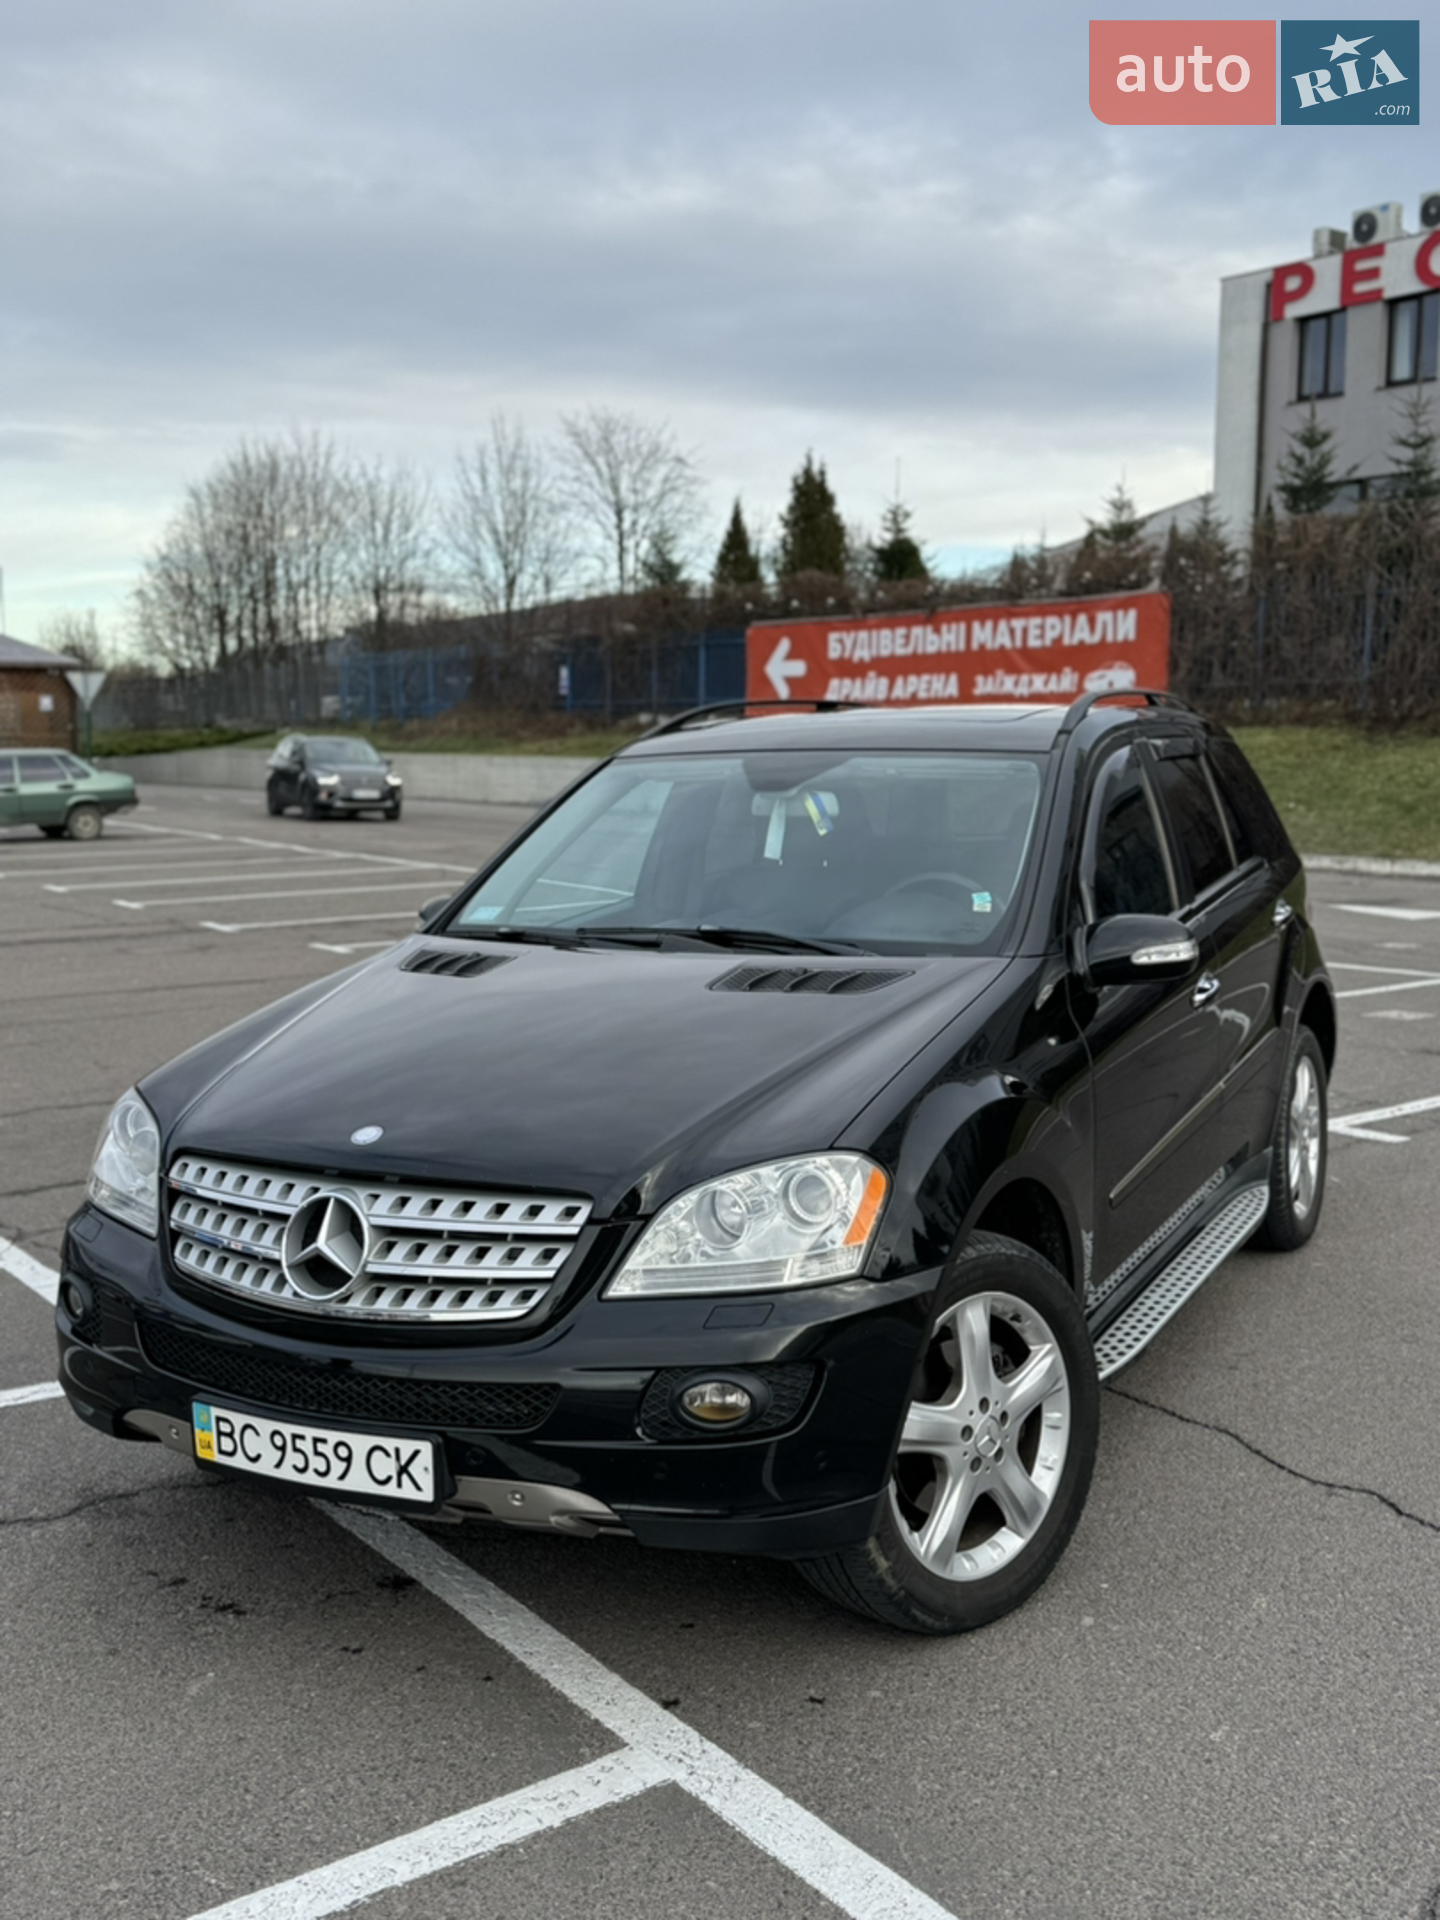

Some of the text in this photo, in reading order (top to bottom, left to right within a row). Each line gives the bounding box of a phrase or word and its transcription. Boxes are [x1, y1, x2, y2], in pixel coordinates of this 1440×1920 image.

[827, 608, 1138, 664] БУДІВЕЛЬНІ МАТЕРІАЛИ
[824, 670, 890, 701] ДРАЙВ
[890, 672, 959, 700] АРЕНА
[269, 1429, 353, 1481] 9559
